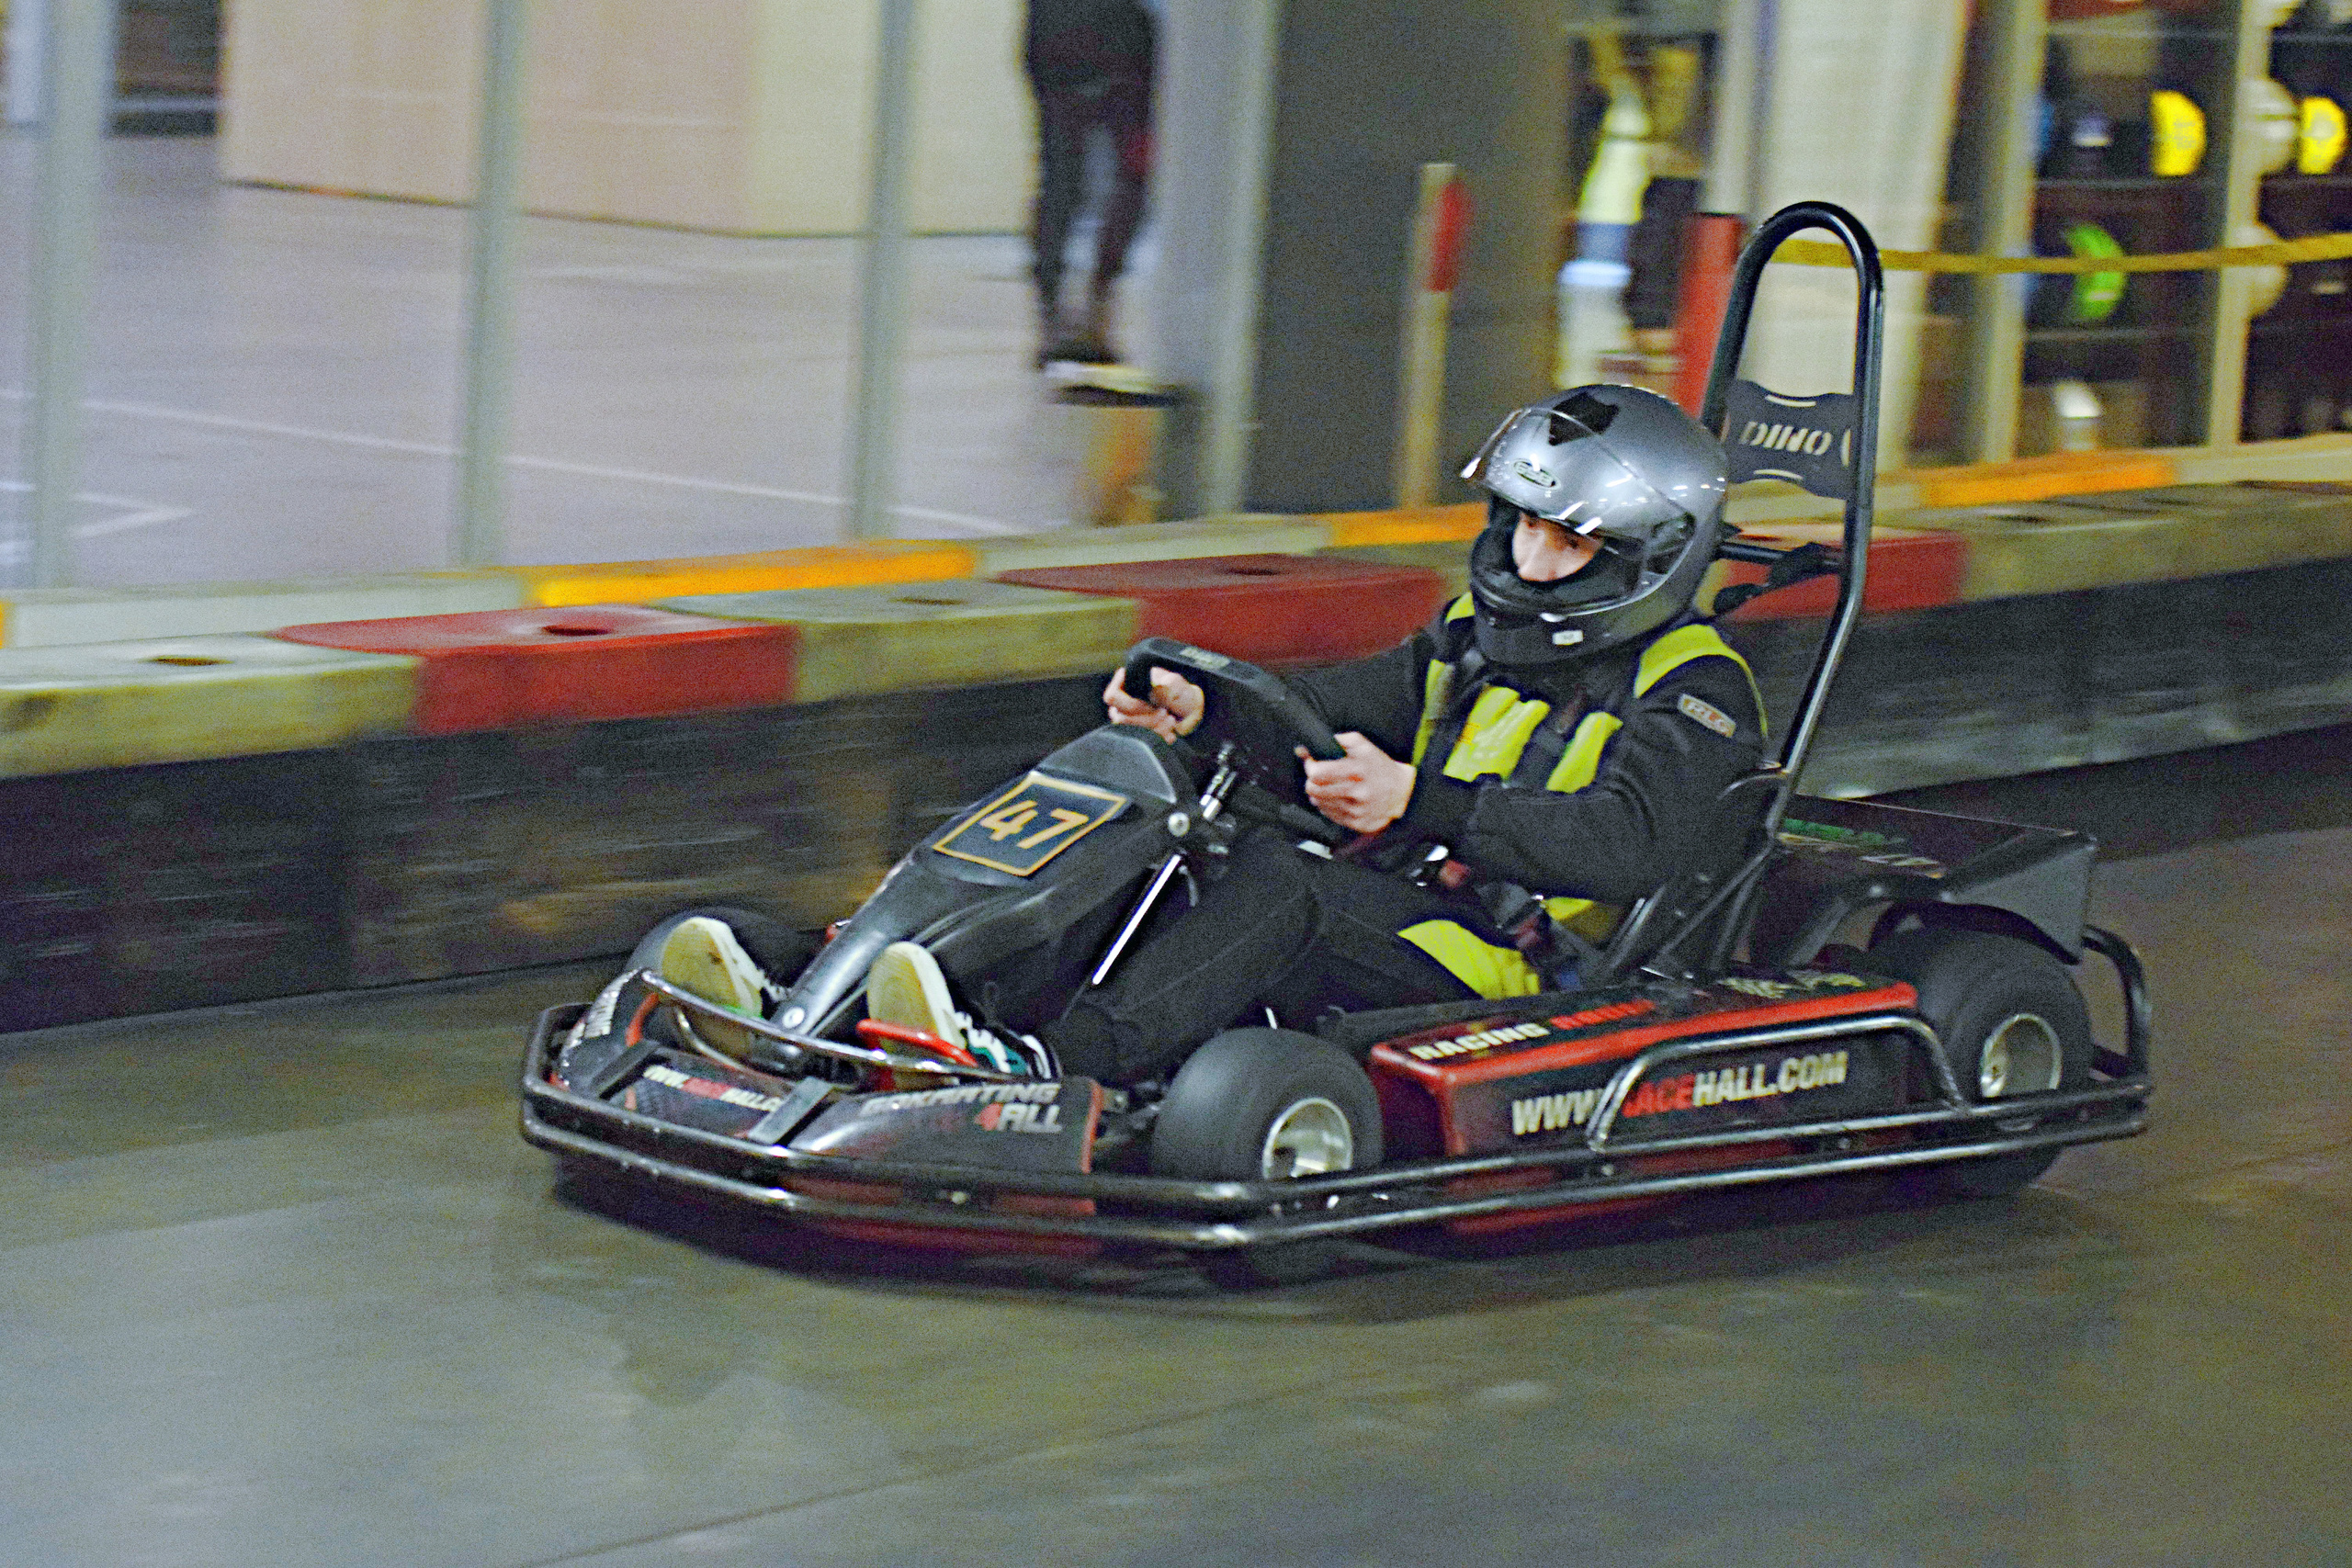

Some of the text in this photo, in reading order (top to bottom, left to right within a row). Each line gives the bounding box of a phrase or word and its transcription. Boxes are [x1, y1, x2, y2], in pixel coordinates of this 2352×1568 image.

[1737, 420, 1833, 456] DINO
[979, 799, 1090, 850] 47
[1408, 1021, 1551, 1061] RACING
[1511, 1051, 1849, 1136] WWWACEHALL.COM
